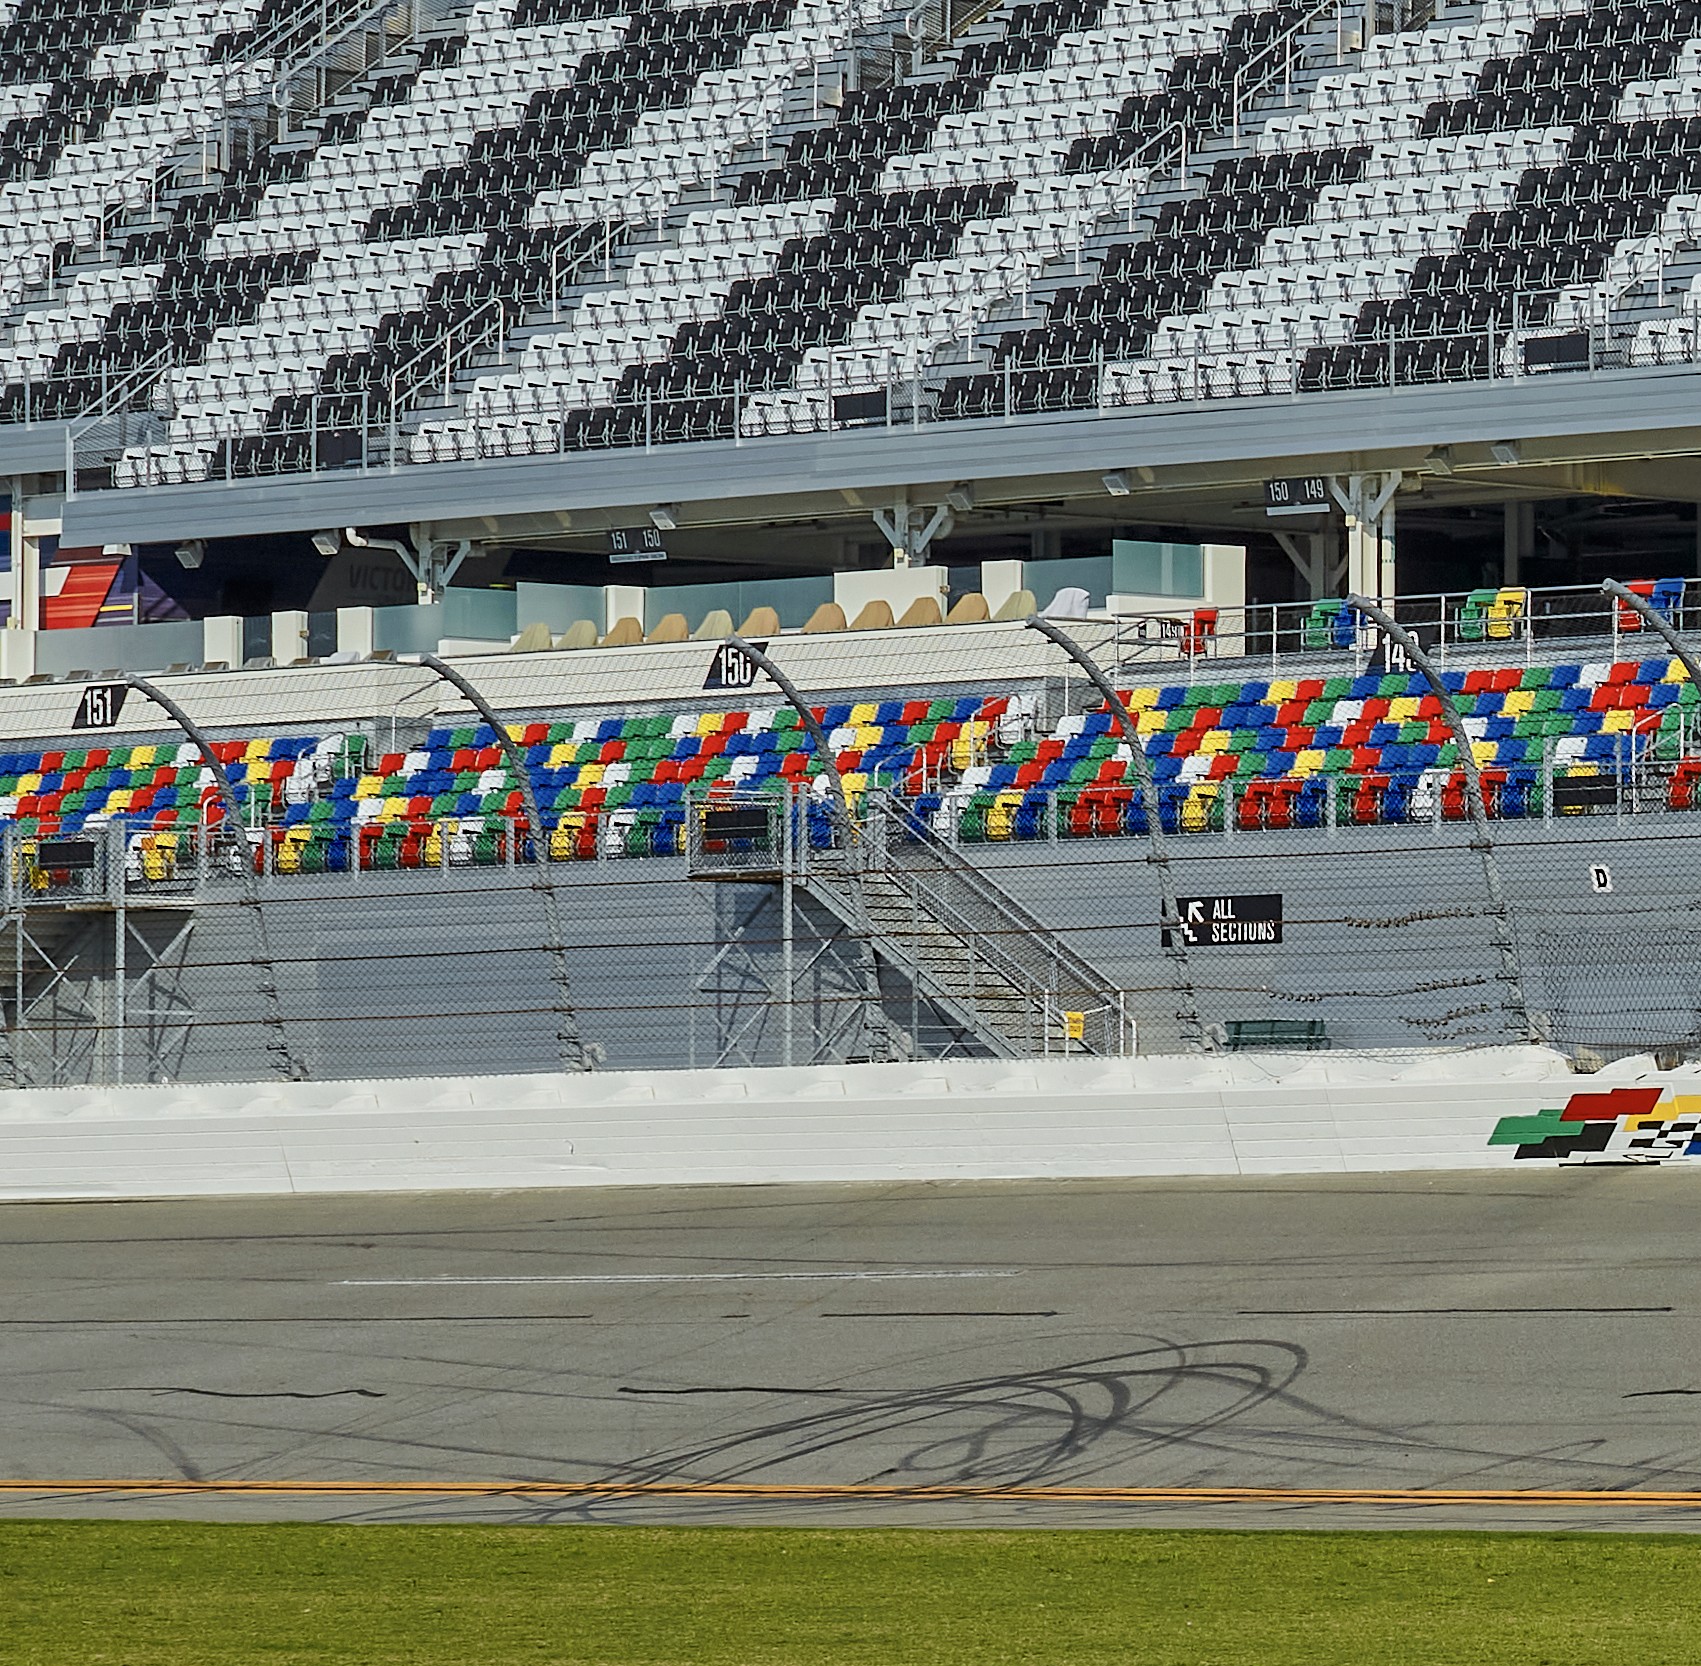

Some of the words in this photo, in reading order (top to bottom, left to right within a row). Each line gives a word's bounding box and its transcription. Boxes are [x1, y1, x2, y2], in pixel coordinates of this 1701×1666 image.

[1269, 481, 1290, 501] 150
[1304, 479, 1324, 499] 149
[611, 530, 628, 549] 151
[642, 529, 661, 547] 150
[83, 687, 114, 726] 151
[1596, 868, 1608, 888] D
[1212, 898, 1236, 920] ALL
[1211, 920, 1275, 942] SECTIONS
